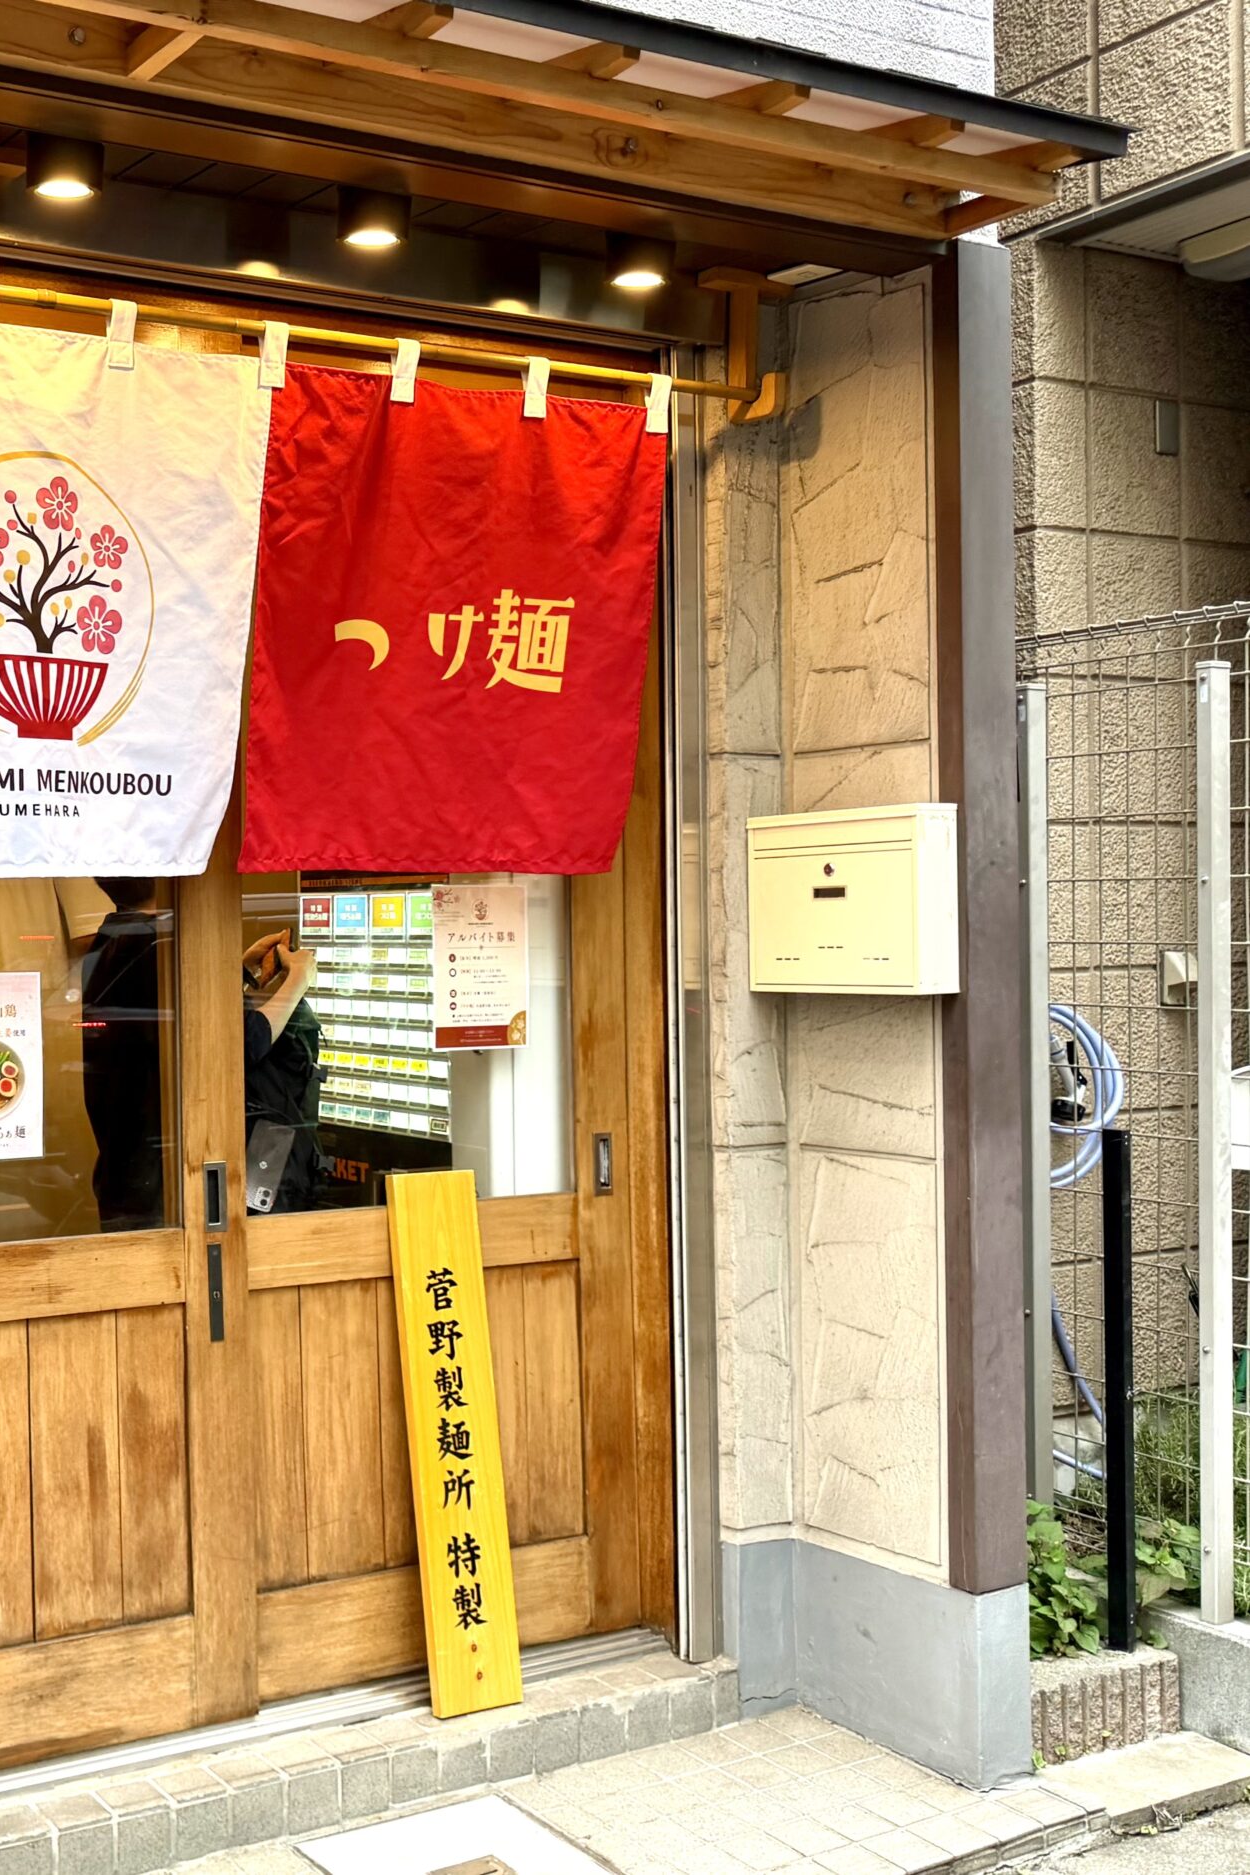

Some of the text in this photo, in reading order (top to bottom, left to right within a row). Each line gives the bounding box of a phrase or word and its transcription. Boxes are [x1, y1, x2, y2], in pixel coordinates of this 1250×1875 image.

[334, 589, 575, 693] つけ麺
[37, 769, 172, 796] MENKOUBOU
[0, 803, 80, 817] UMEHARA
[447, 931, 515, 943] アルバイト募集
[425, 1267, 488, 1630] 菅野製麺所 特製
